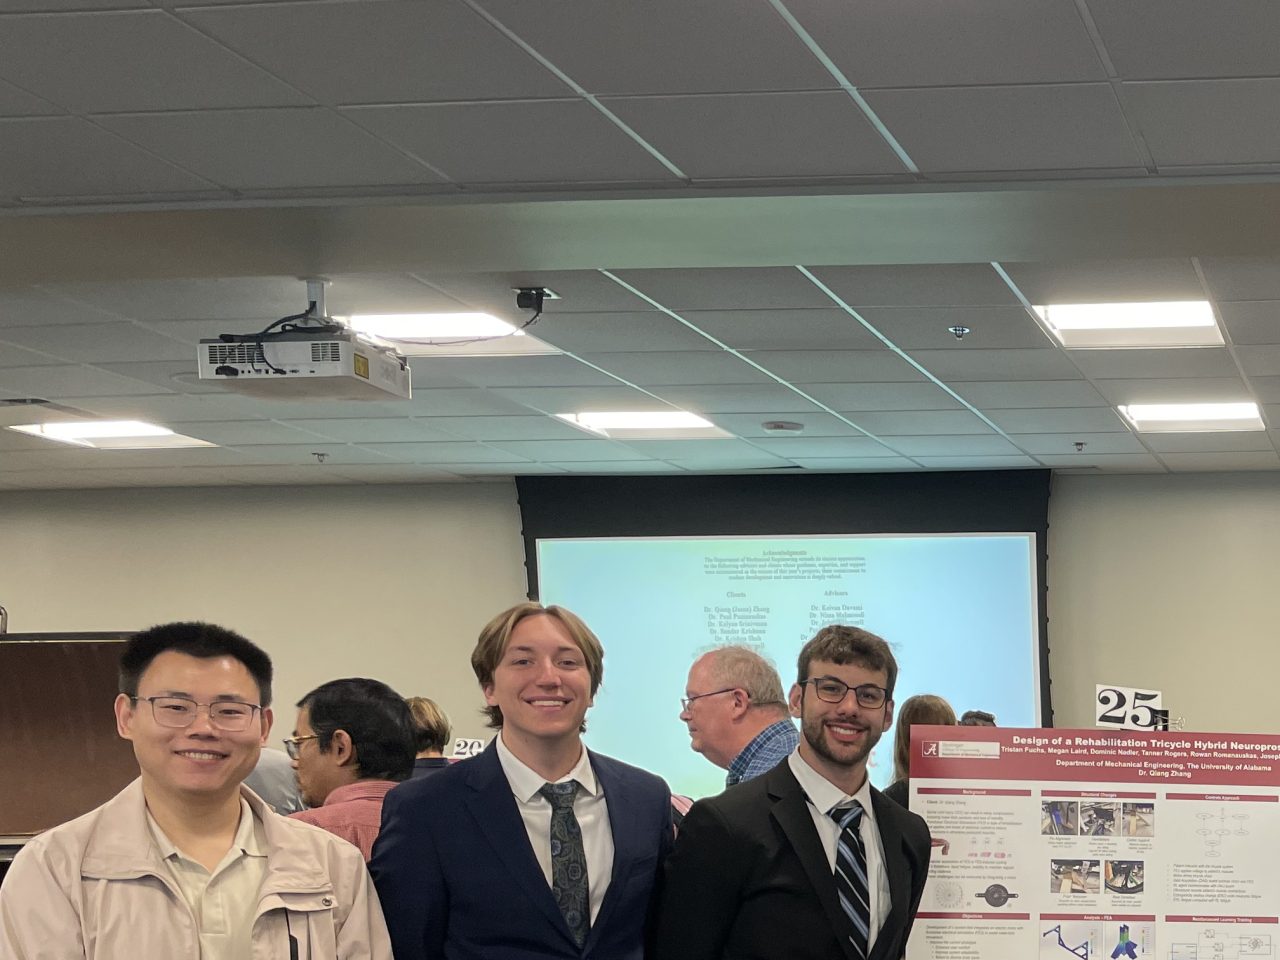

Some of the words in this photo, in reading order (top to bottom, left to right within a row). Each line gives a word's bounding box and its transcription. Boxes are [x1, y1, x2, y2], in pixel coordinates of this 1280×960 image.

[1098, 689, 1158, 727] 25
[1013, 736, 1049, 746] Design
[1051, 737, 1062, 745] of
[1075, 737, 1147, 747] Rehabilitation
[1150, 739, 1191, 749] Tricycle
[1194, 740, 1227, 750] Hybrid
[1048, 747, 1069, 755] Megan
[1056, 759, 1095, 767] Department
[1144, 761, 1185, 769] Engineering,
[1201, 763, 1234, 771] University
[1170, 770, 1191, 778] Zhang
